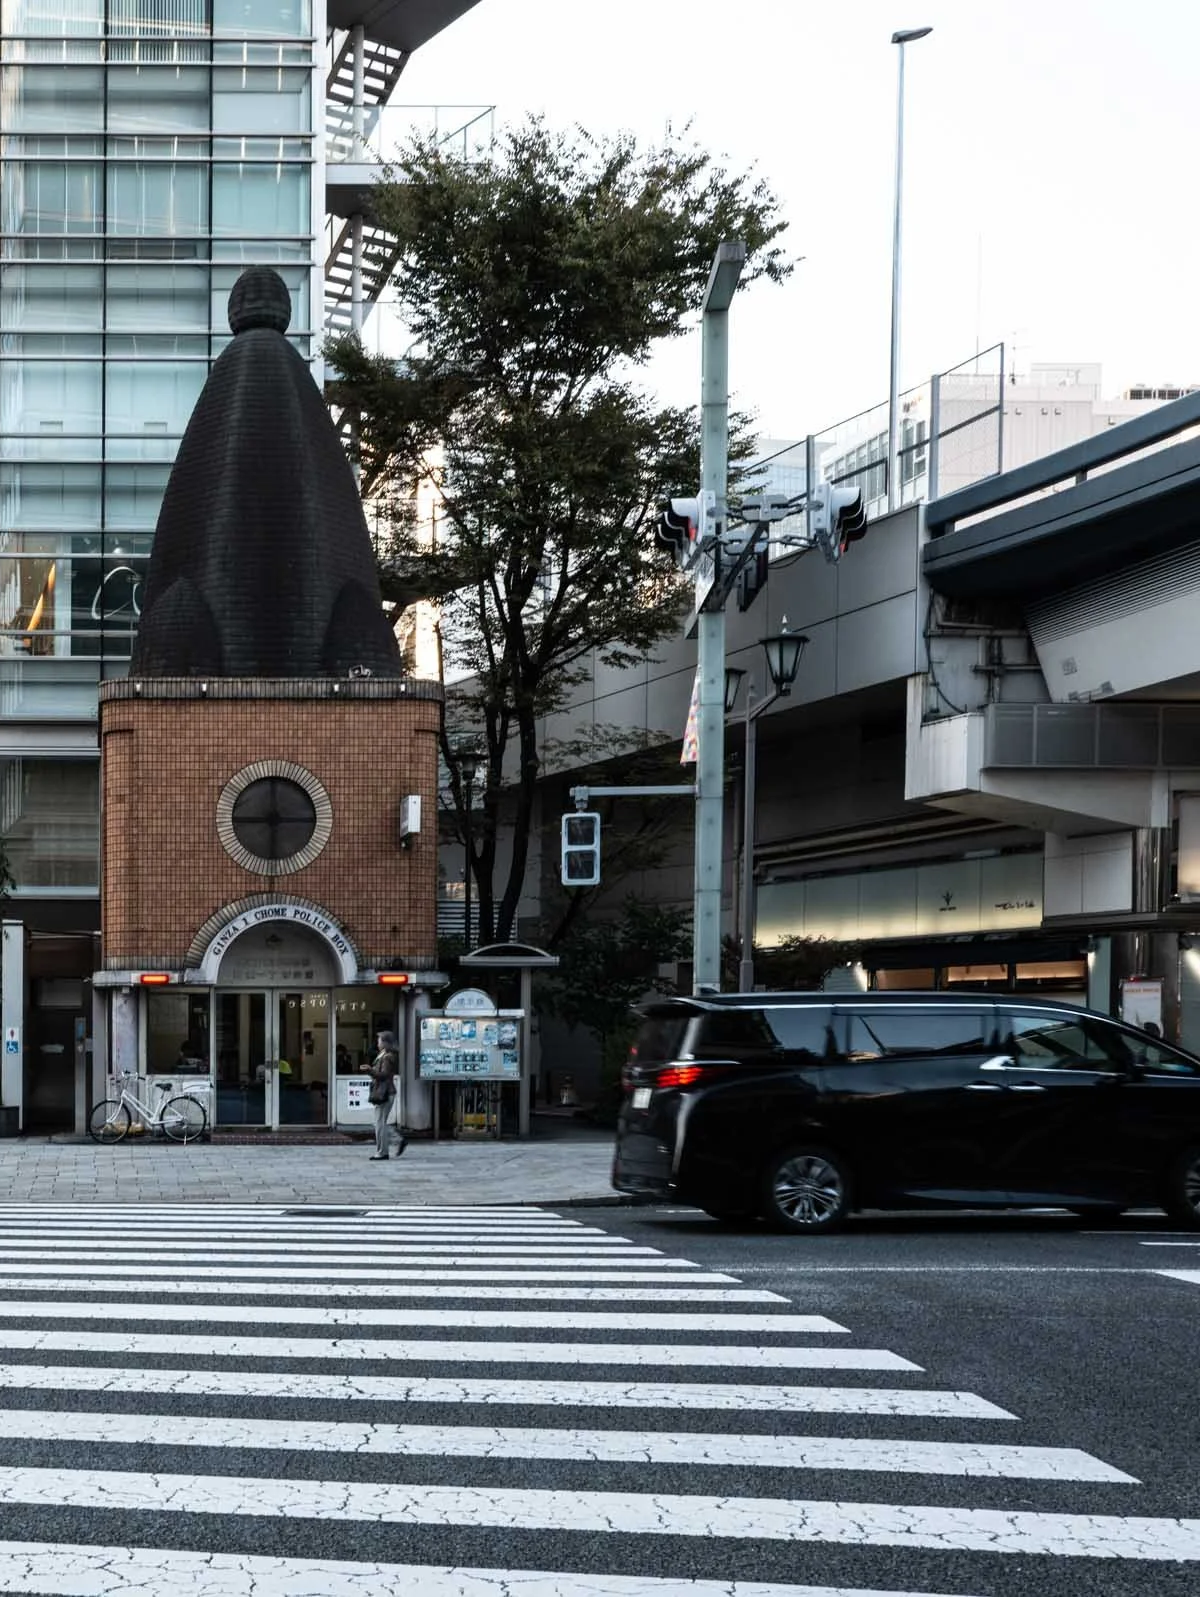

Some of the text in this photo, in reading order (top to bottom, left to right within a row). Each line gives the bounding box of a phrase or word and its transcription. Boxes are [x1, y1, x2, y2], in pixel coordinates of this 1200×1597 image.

[212, 925, 239, 956] GINZA
[254, 907, 288, 921] CHOME
[293, 908, 331, 934] POLICE
[331, 932, 349, 956] BOX
